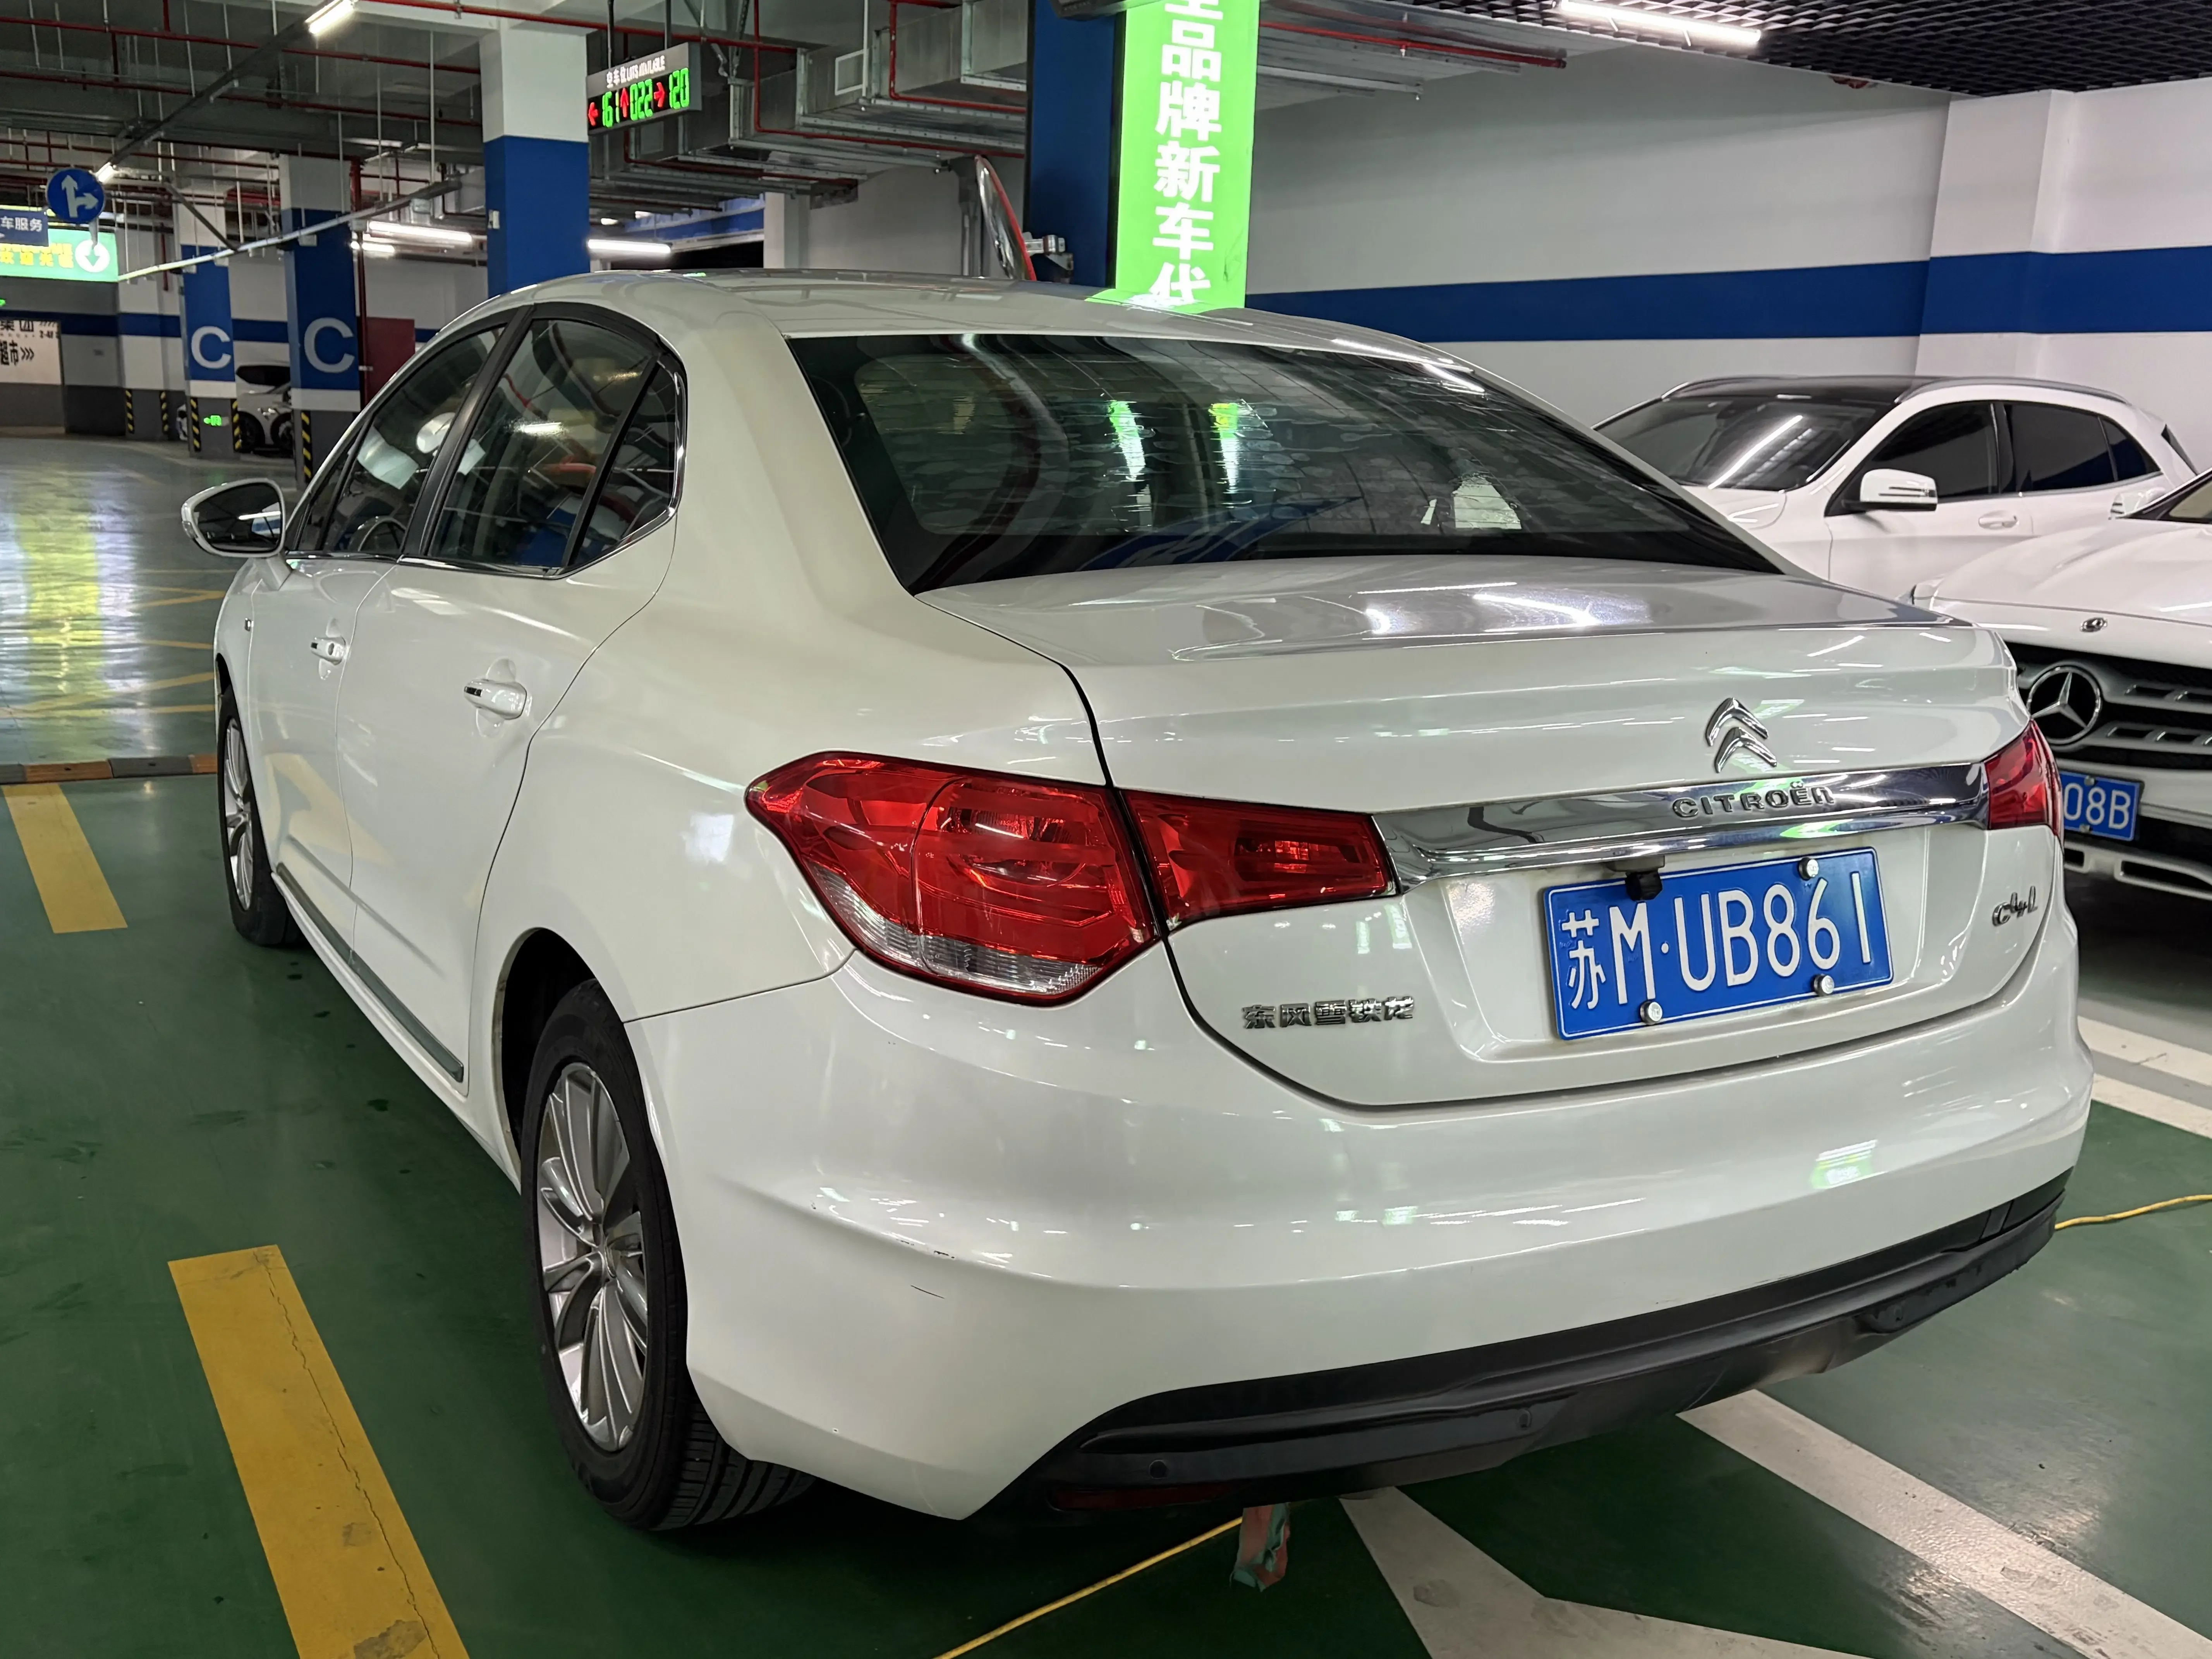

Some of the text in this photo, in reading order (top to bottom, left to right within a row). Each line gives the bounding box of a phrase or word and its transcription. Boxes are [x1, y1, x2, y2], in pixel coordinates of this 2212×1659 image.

[639, 55, 665, 77] AVAILABLE
[630, 79, 653, 121] 022
[669, 67, 690, 109] 120
[0, 216, 43, 232] 车服务
[191, 326, 232, 369] C
[304, 317, 355, 373] C
[1243, 996, 1414, 1029] 东风雪铁龙
